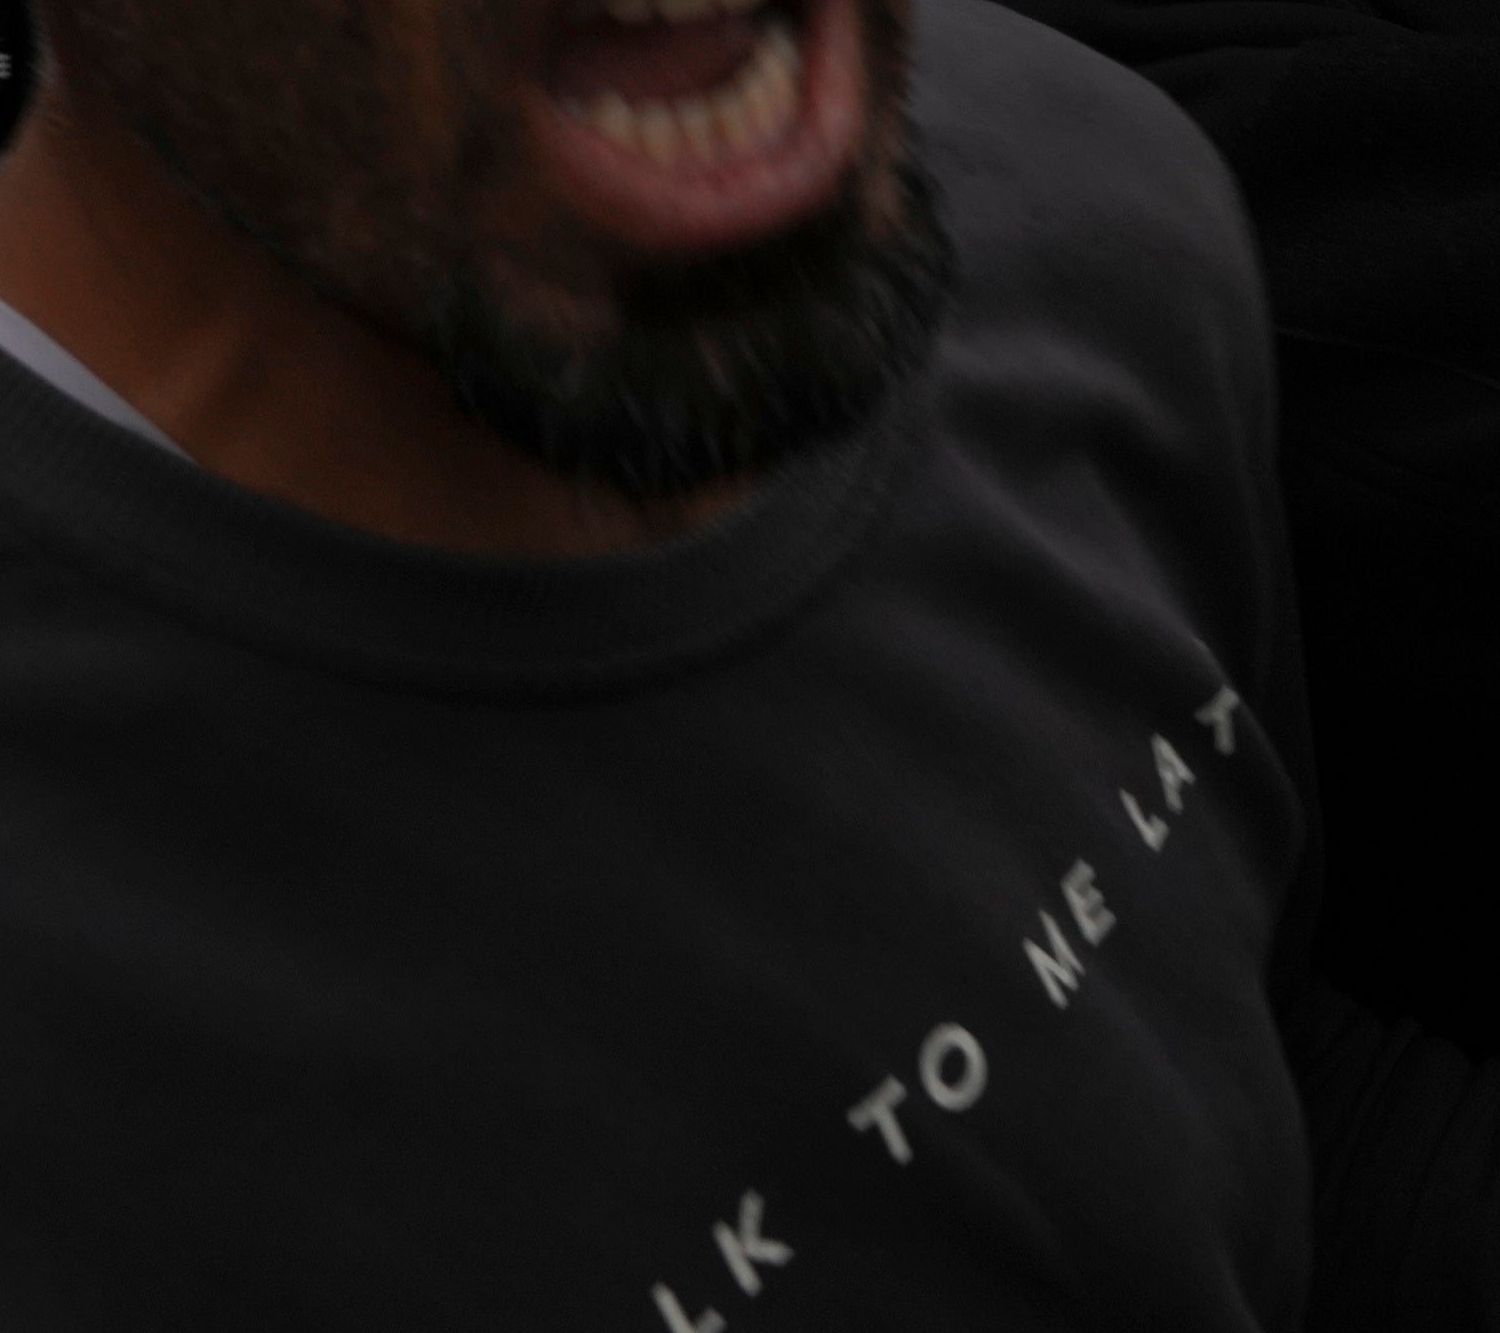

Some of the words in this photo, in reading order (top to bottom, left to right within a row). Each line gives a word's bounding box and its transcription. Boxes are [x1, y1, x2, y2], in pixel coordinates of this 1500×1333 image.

[846, 1021, 988, 1165] TO
[1022, 859, 1117, 1009] ME
[1119, 685, 1241, 852] LAT
